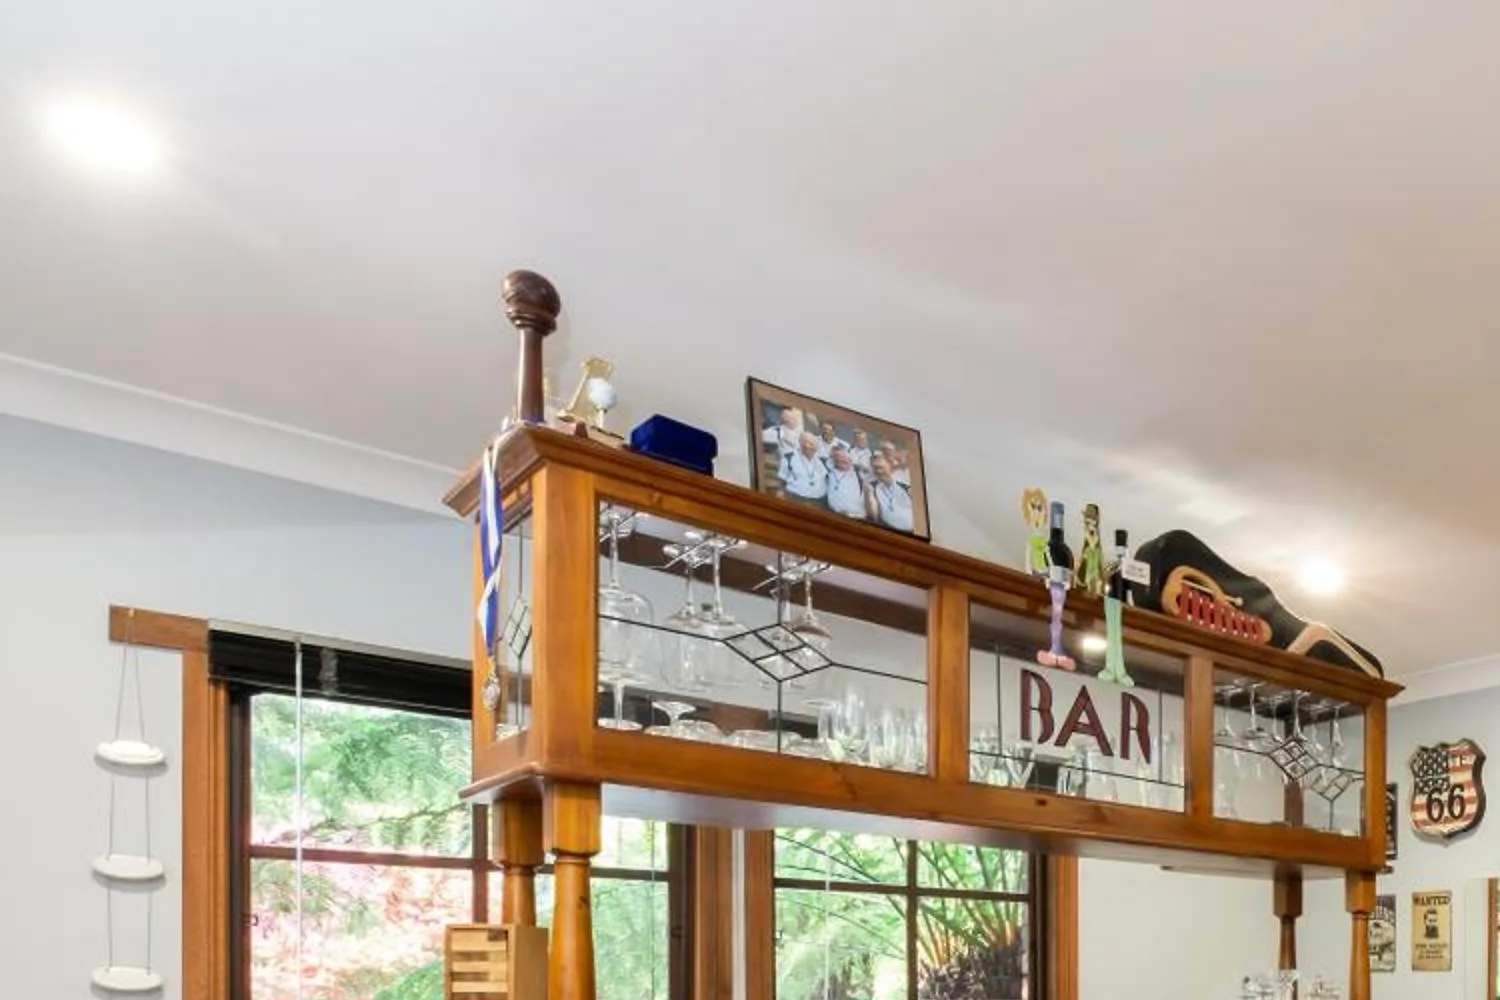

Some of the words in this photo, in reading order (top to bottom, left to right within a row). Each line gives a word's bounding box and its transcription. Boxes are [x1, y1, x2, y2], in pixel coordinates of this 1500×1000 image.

[1020, 668, 1152, 765] BAR
[1426, 783, 1466, 823] 66
[1413, 895, 1451, 906] WANTED
